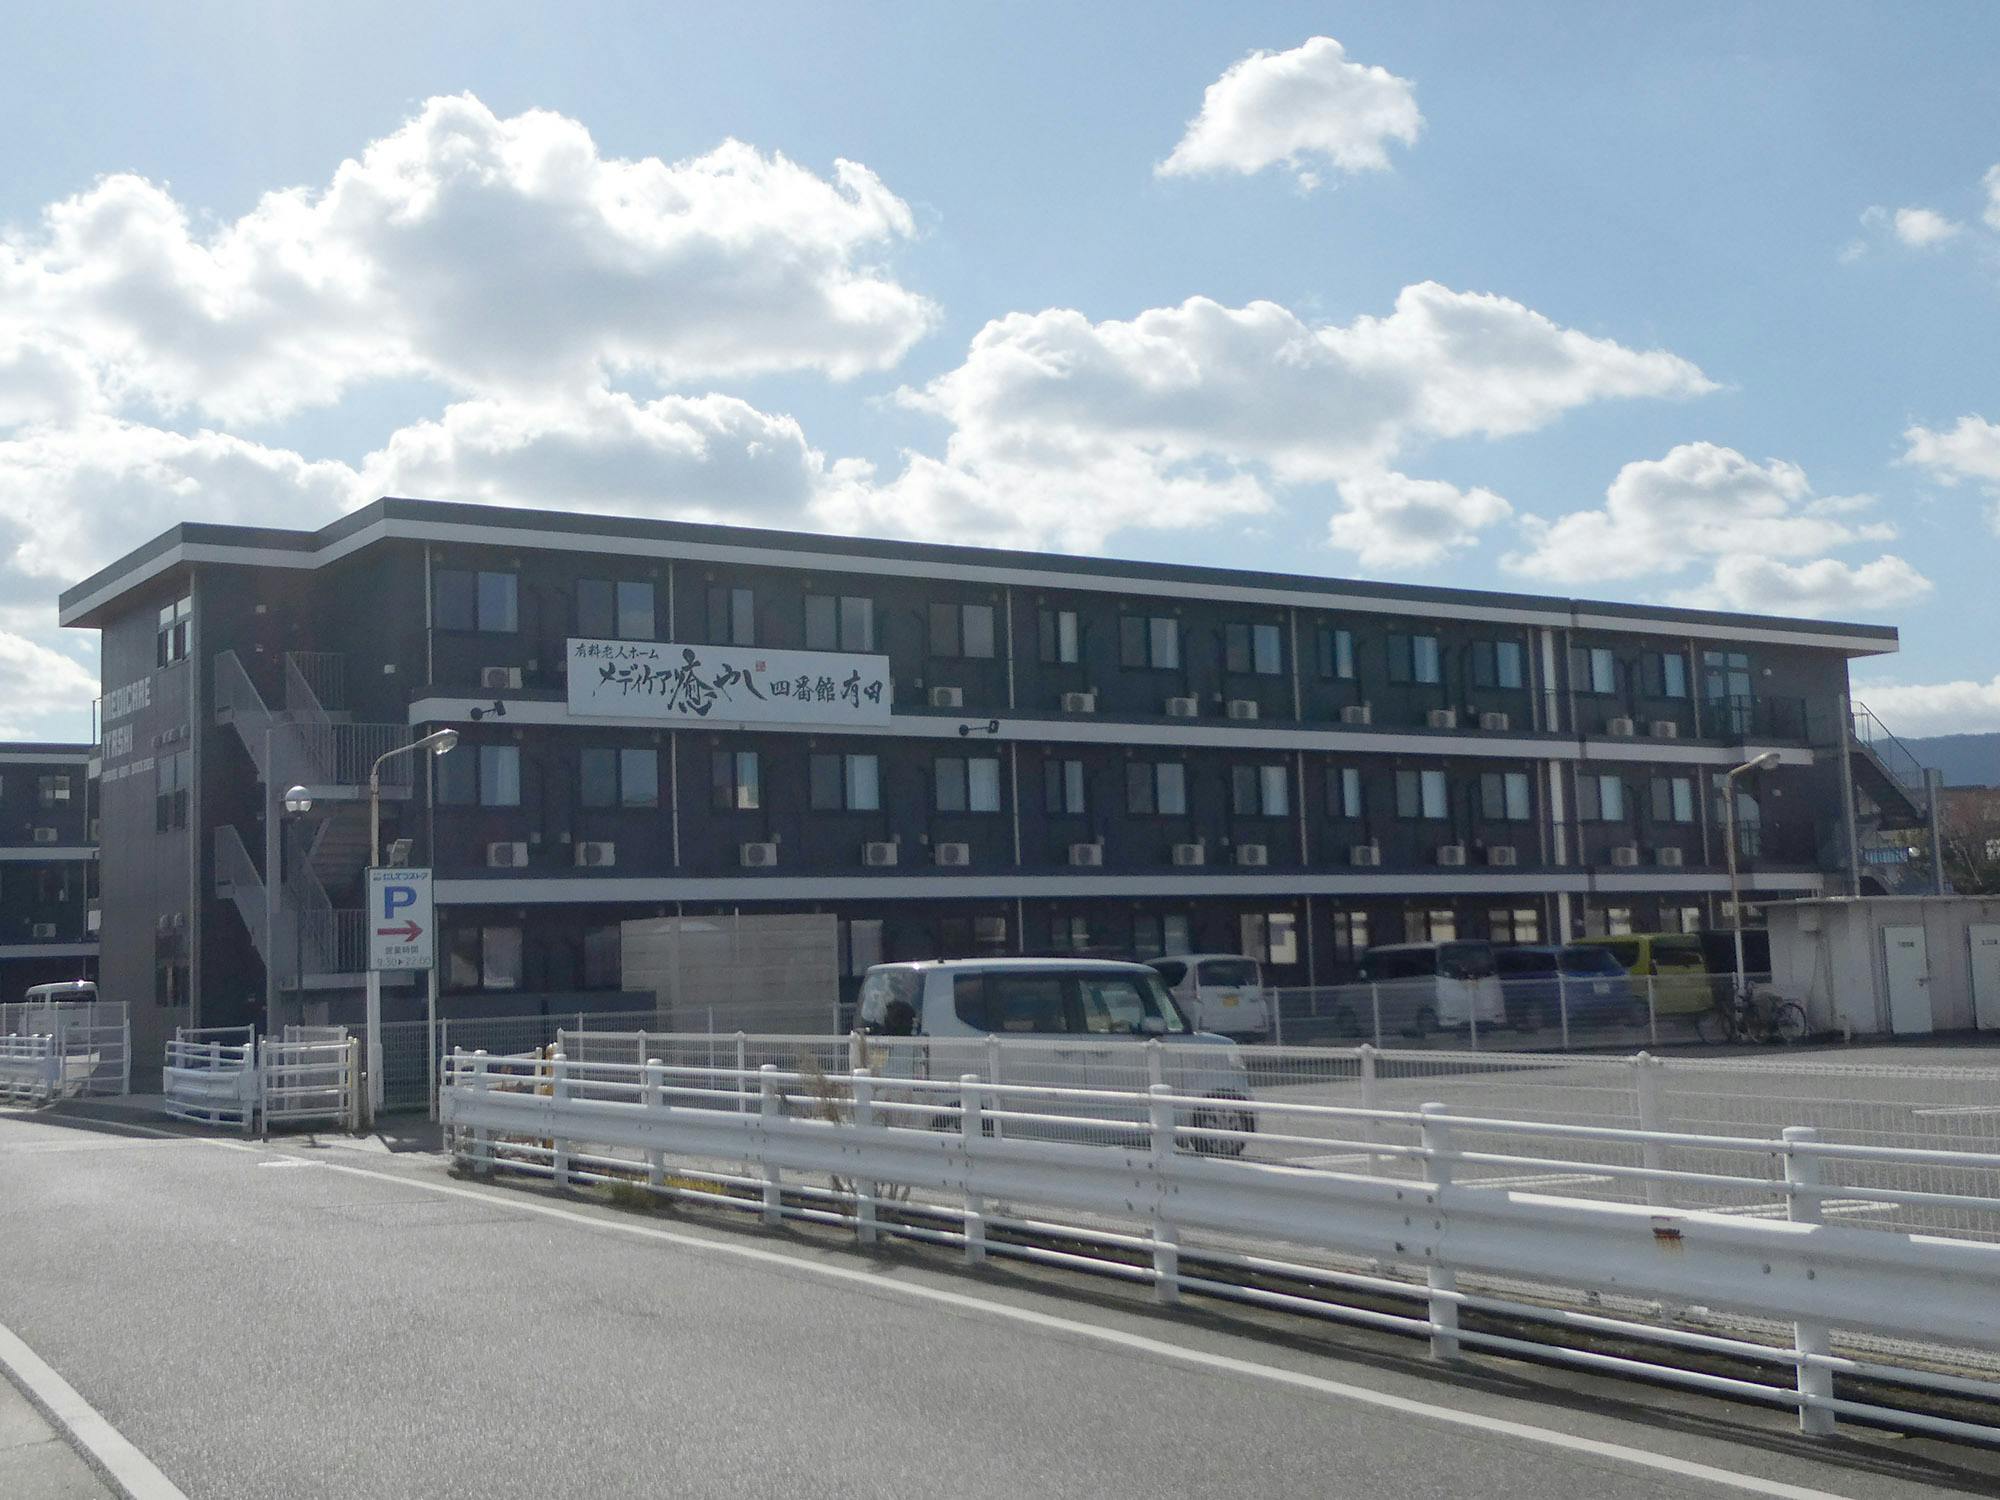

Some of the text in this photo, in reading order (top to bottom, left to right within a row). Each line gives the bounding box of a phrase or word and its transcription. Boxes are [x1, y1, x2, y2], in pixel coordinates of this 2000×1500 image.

[574, 643, 660, 660] 有料老人ホーム
[103, 676, 151, 722] MEDICARE
[102, 723, 133, 760] IYASHI
[384, 886, 417, 919] P
